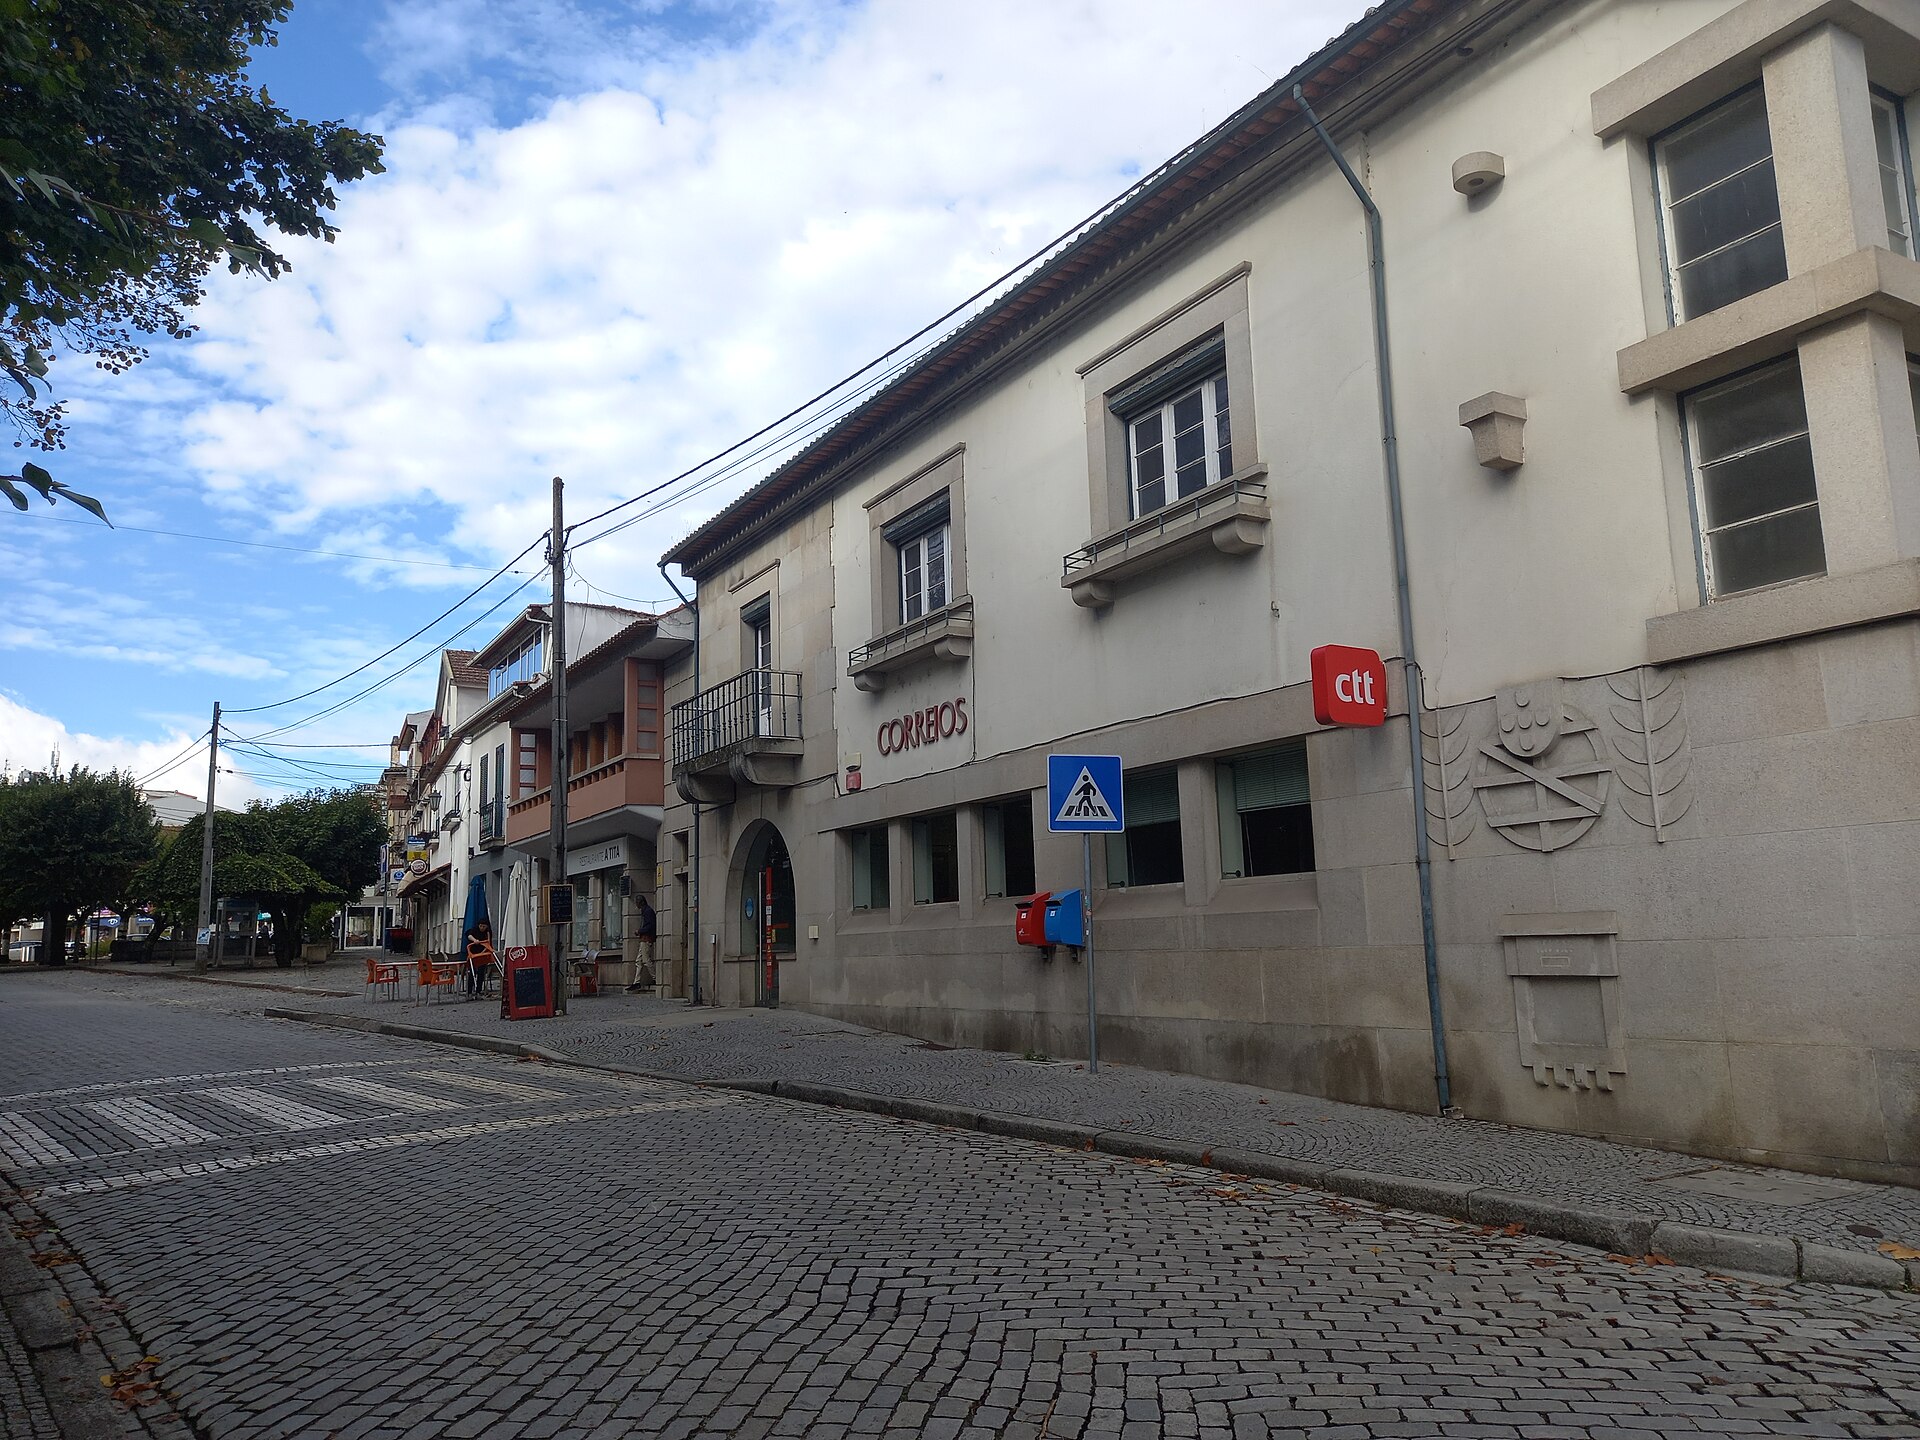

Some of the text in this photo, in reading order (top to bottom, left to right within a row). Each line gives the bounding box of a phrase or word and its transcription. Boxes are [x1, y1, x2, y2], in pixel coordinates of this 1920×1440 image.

[1335, 668, 1375, 705] ctt
[877, 697, 968, 756] CORREIOS
[604, 848, 609, 862] A
[609, 845, 620, 860] TITA
